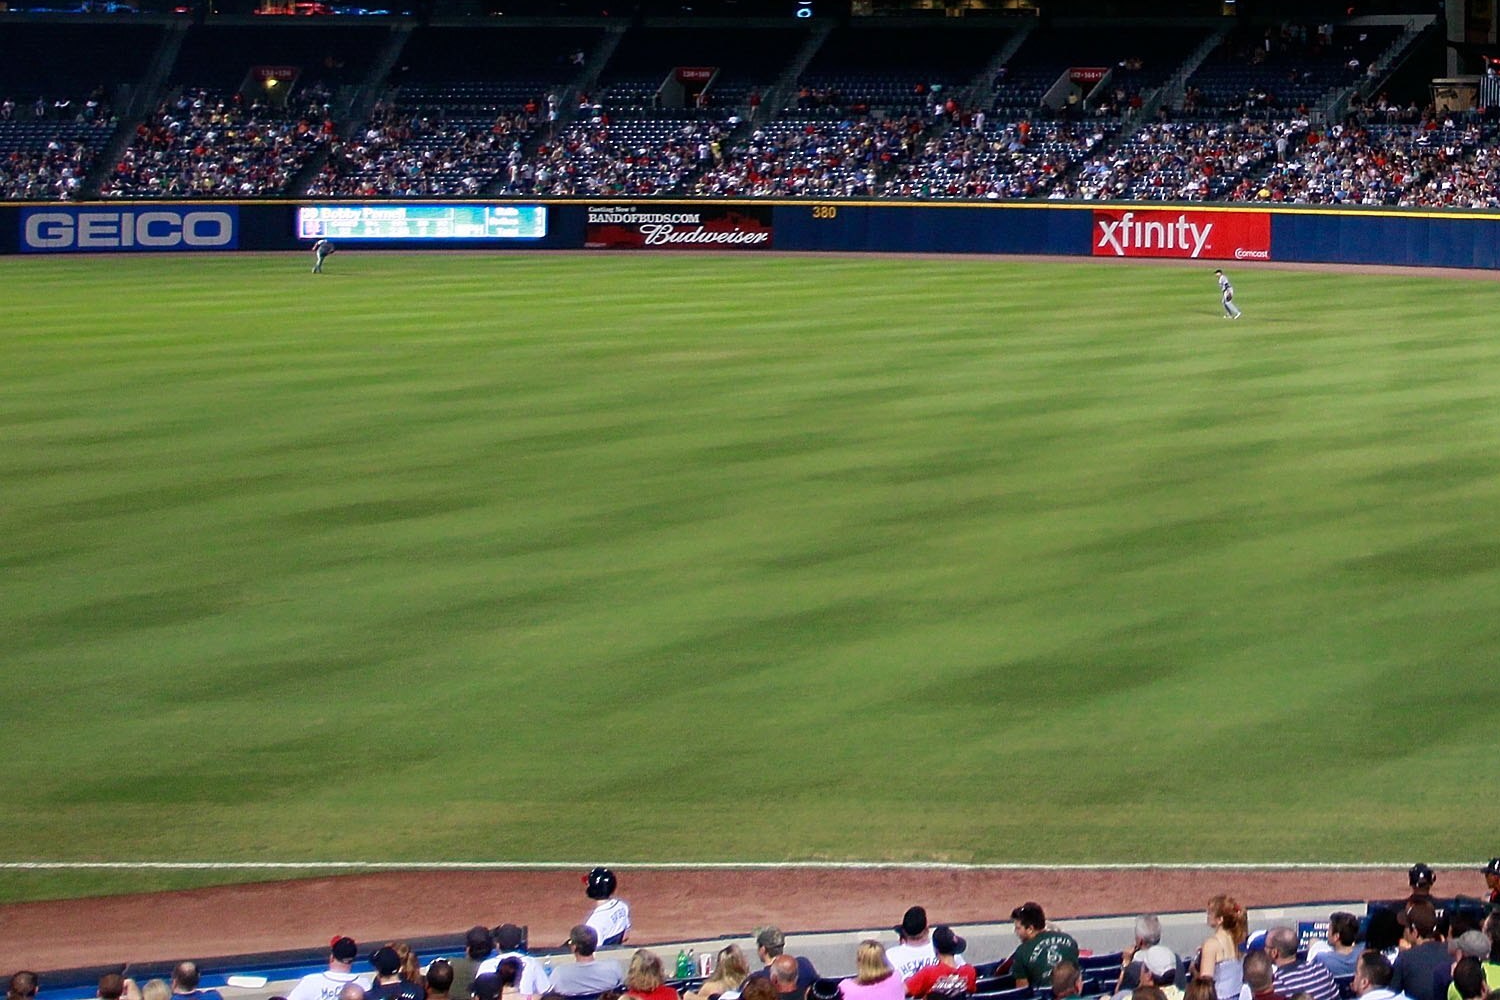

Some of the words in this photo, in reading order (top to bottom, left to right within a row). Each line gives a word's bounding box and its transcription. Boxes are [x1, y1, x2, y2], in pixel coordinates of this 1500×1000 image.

[588, 213, 700, 223] BANDOFBUDS.COM
[812, 207, 837, 219] 380
[25, 211, 233, 248] GEICO
[639, 224, 769, 245] Budweiser
[1098, 213, 1213, 258] xfinity
